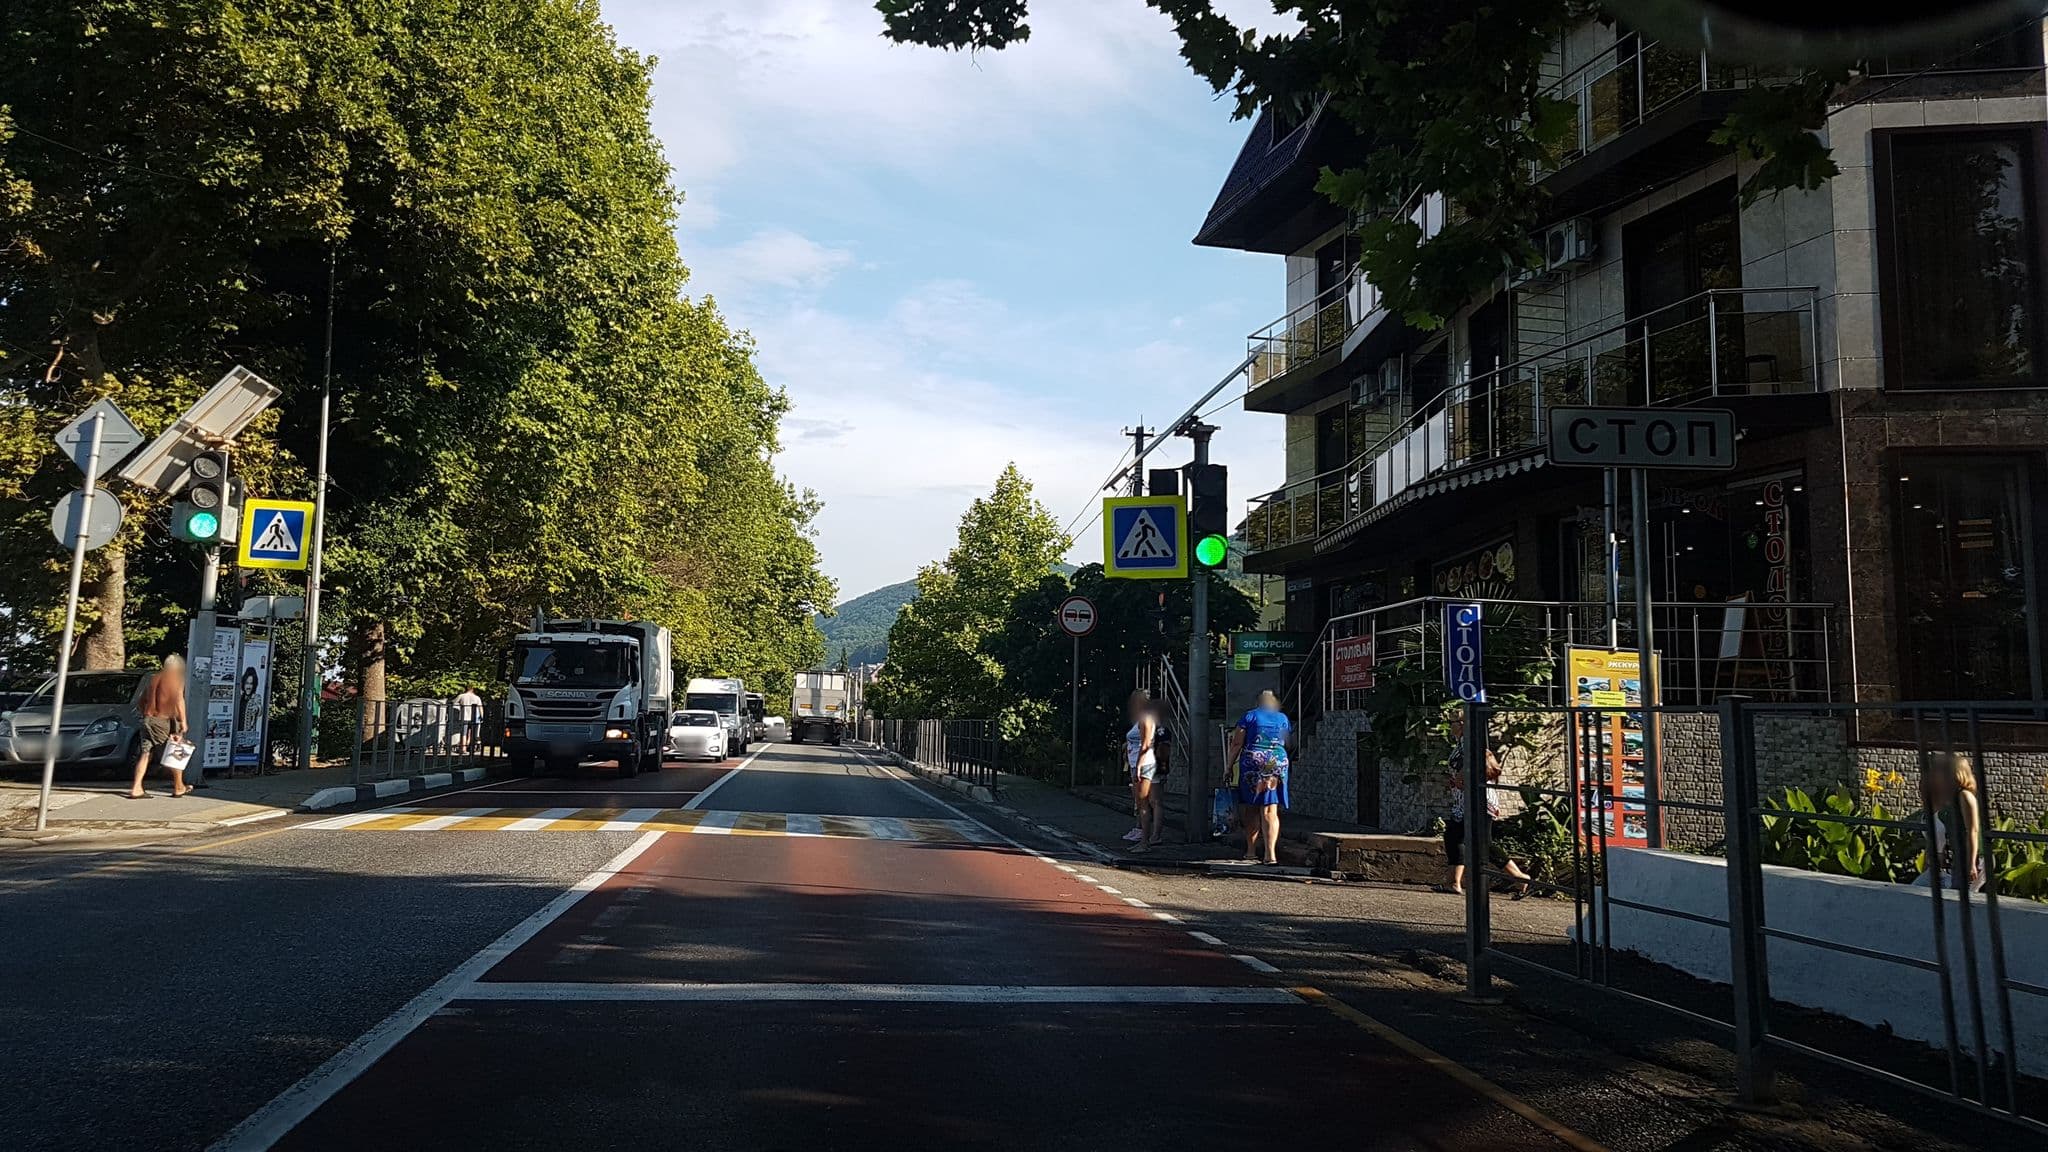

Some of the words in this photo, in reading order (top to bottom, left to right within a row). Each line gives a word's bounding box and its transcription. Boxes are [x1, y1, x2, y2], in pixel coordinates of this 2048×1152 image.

[1568, 417, 1717, 457] СТОП
[1243, 640, 1294, 649] ЭКСКУРСИИ
[1456, 608, 1477, 700] СТОЛО
[1608, 661, 1640, 669] ЭКСКУР
[547, 690, 587, 698] SCANIA
